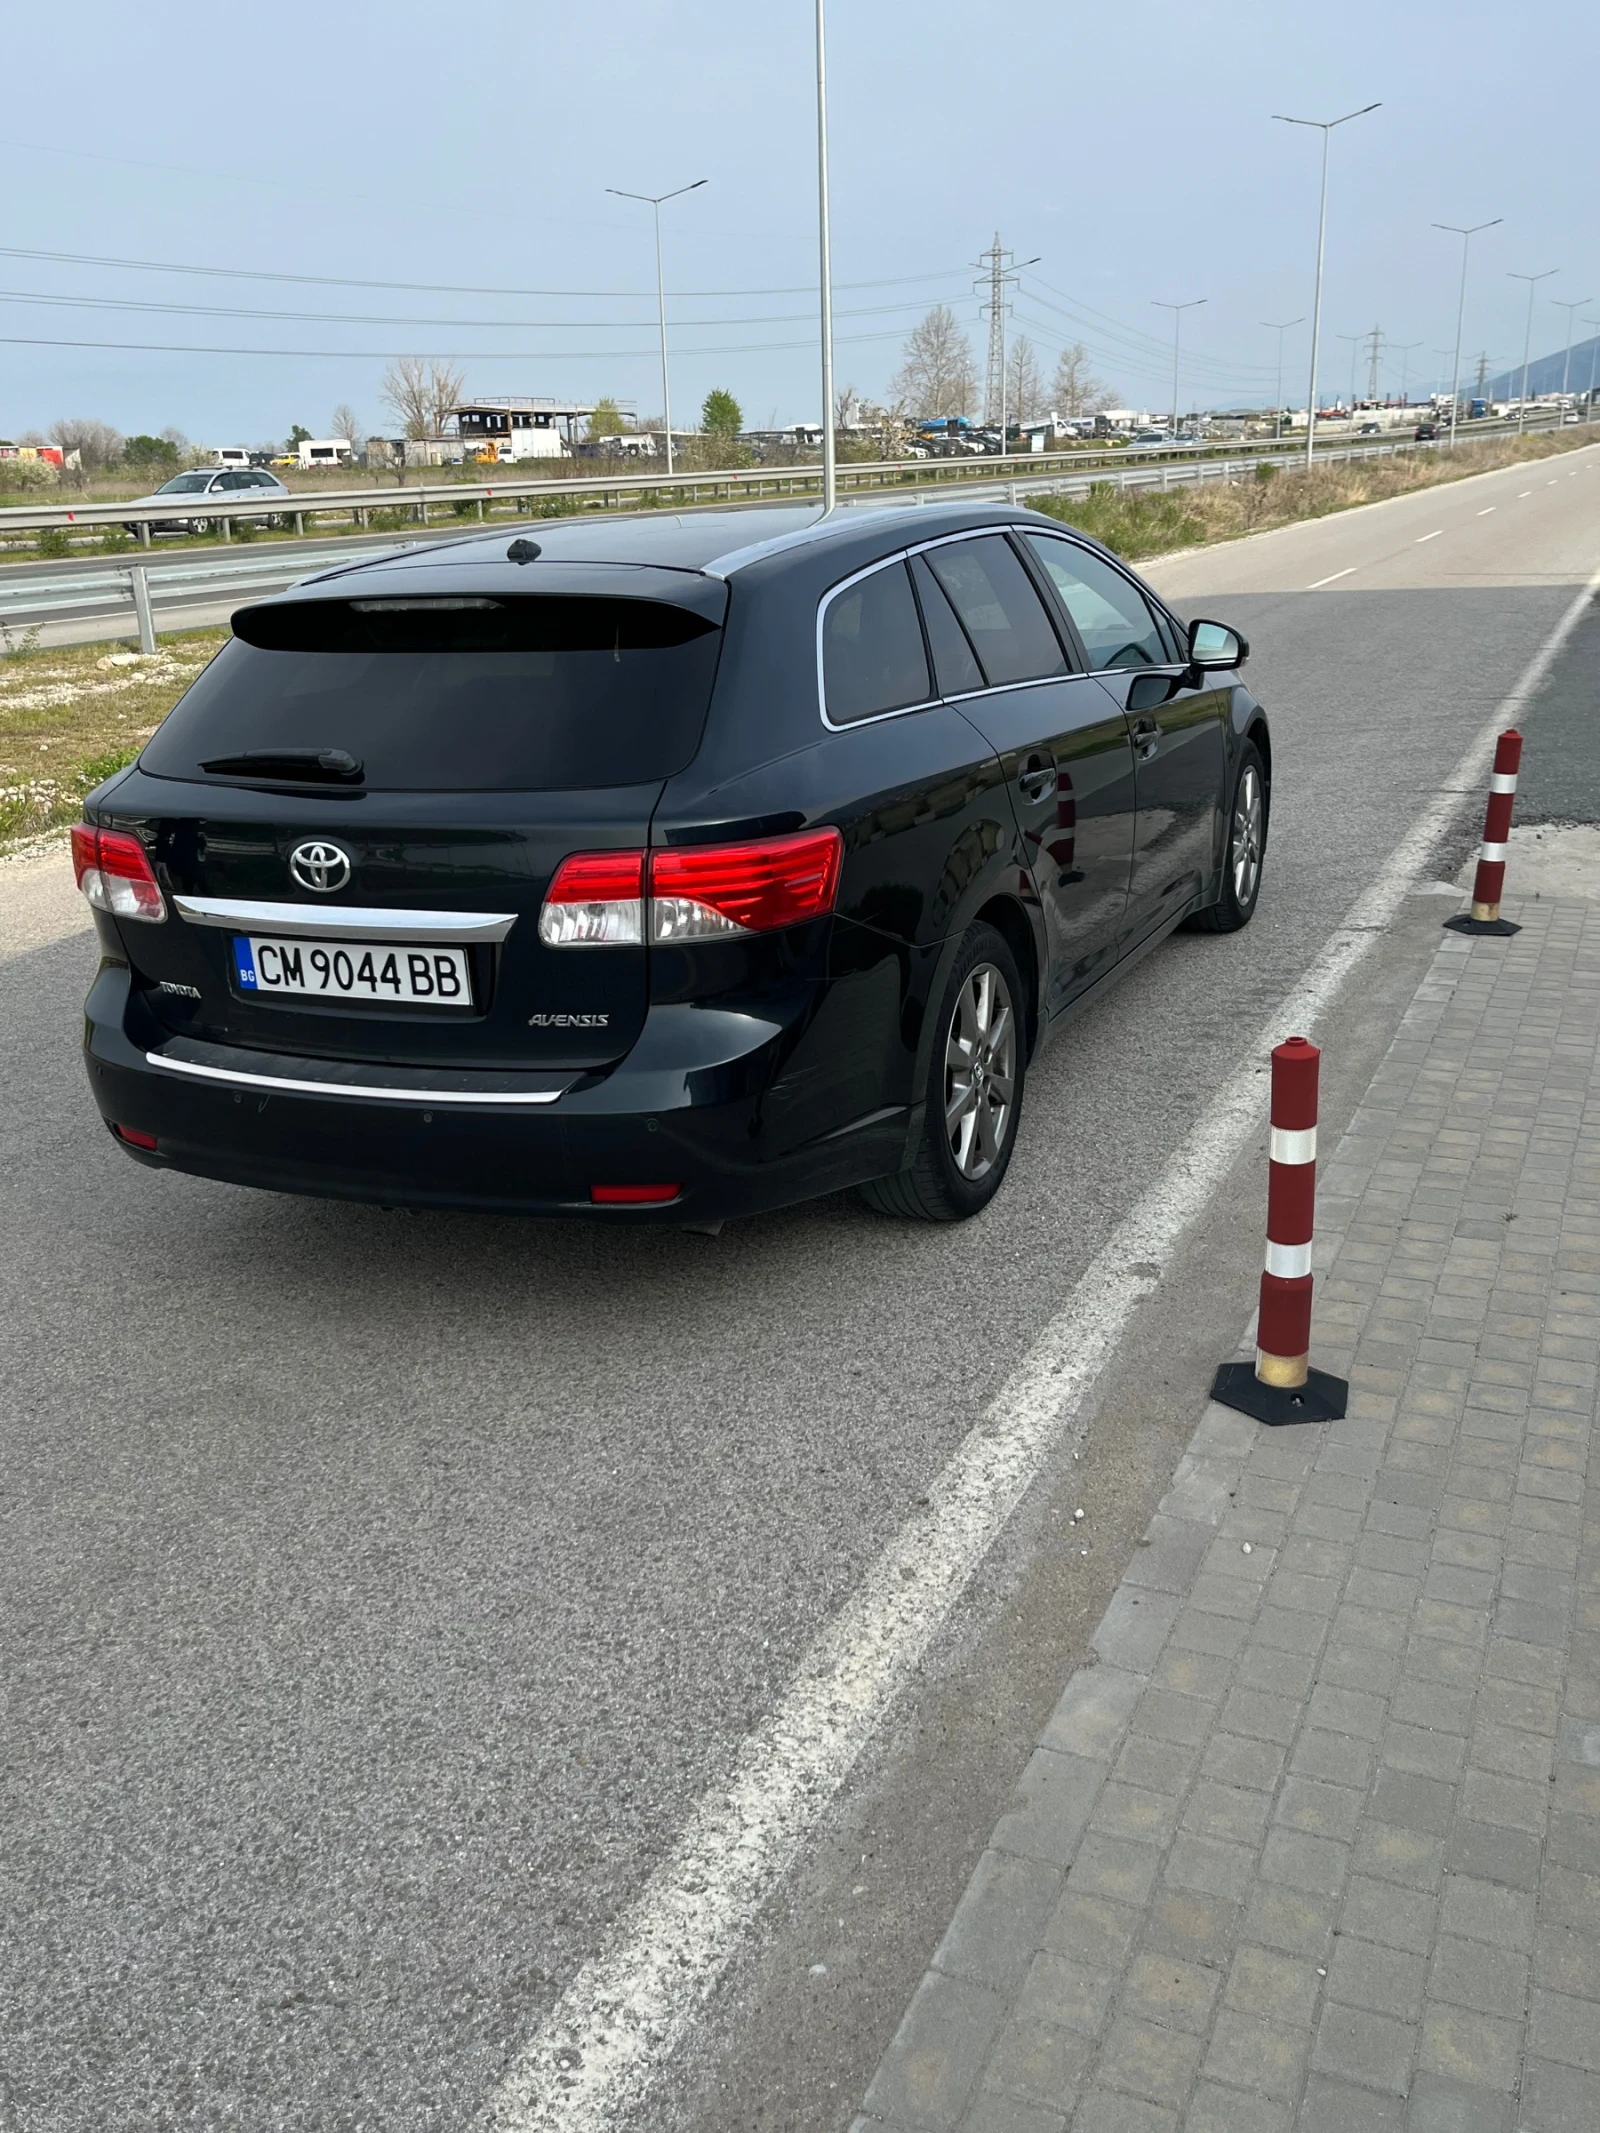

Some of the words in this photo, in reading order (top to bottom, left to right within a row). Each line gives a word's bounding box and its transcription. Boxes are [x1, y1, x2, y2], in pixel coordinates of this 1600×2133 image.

[240, 969, 255, 982] BG
[257, 945, 305, 988] CM
[310, 949, 402, 995] 9044
[407, 954, 461, 997] BB
[160, 981, 202, 998] TOYOTA
[528, 1014, 609, 1027] AVENSIS
